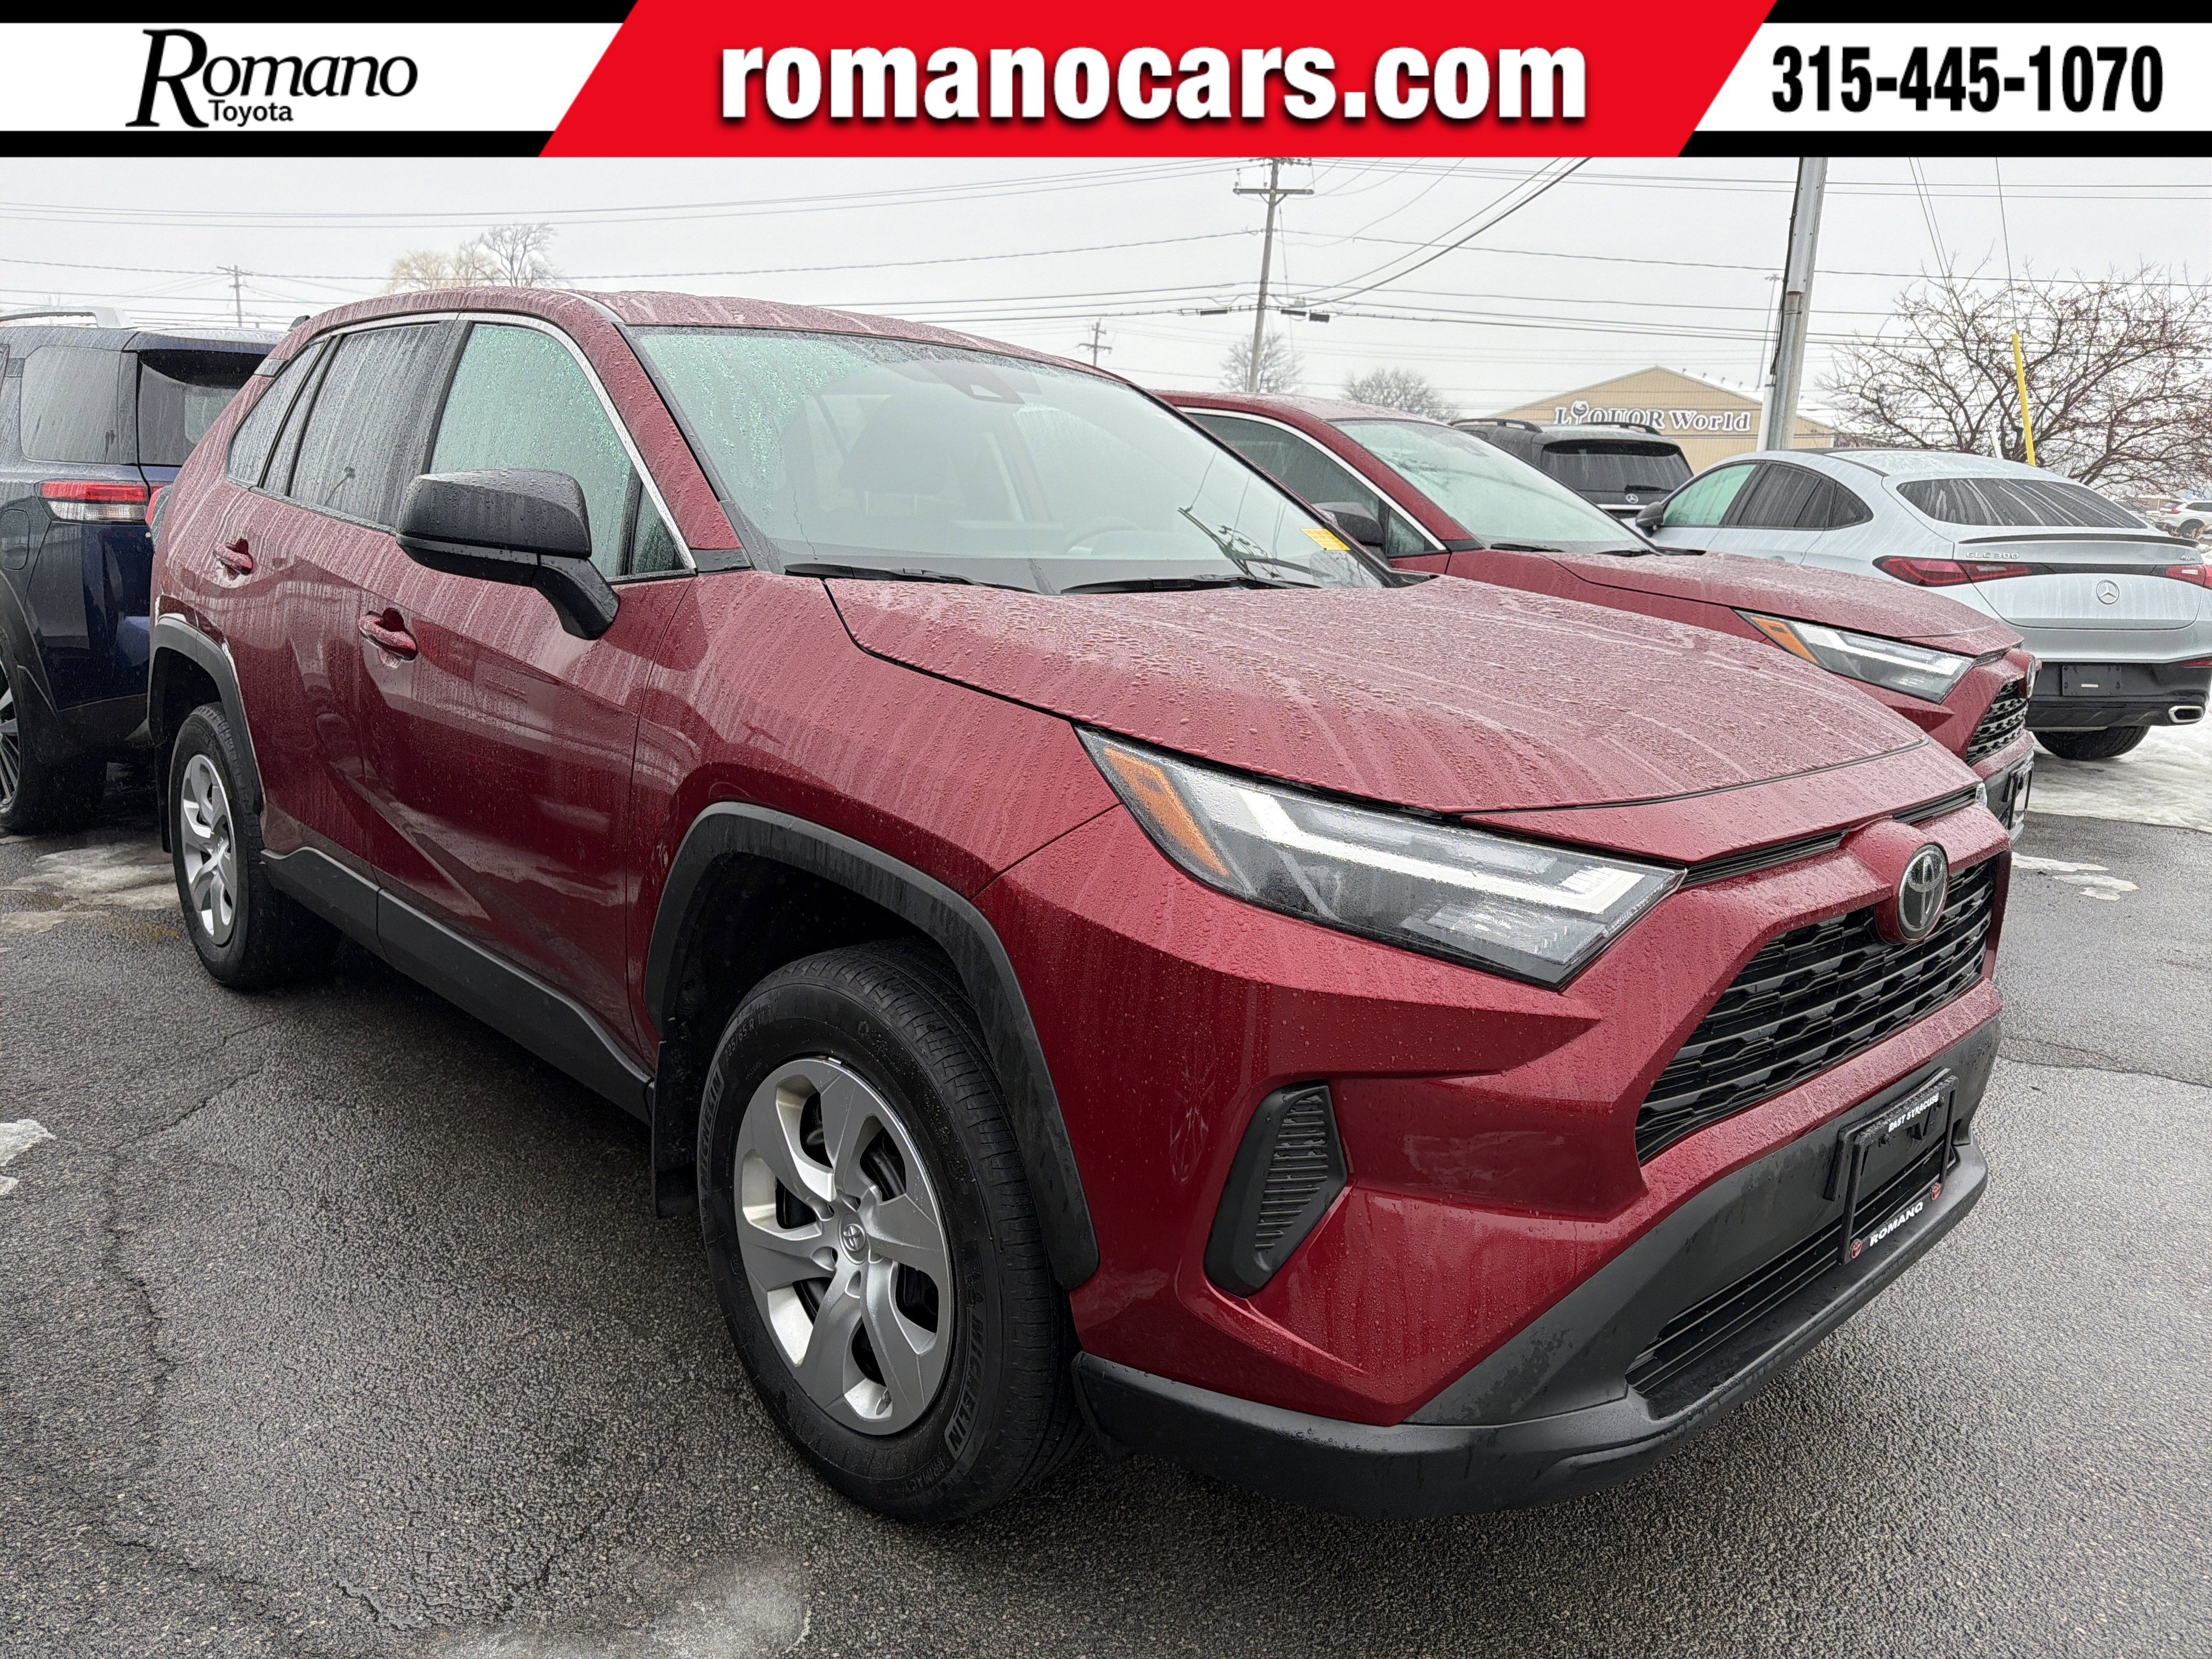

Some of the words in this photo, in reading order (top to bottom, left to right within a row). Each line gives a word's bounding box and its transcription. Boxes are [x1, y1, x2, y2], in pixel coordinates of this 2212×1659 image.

[1669, 410, 1751, 431] World
[1888, 1114, 1906, 1132] EAST
[1906, 1092, 1939, 1120] SYRACUSE
[1870, 1201, 1923, 1248] ROMANO
[948, 1314, 984, 1452] MICHELIN
